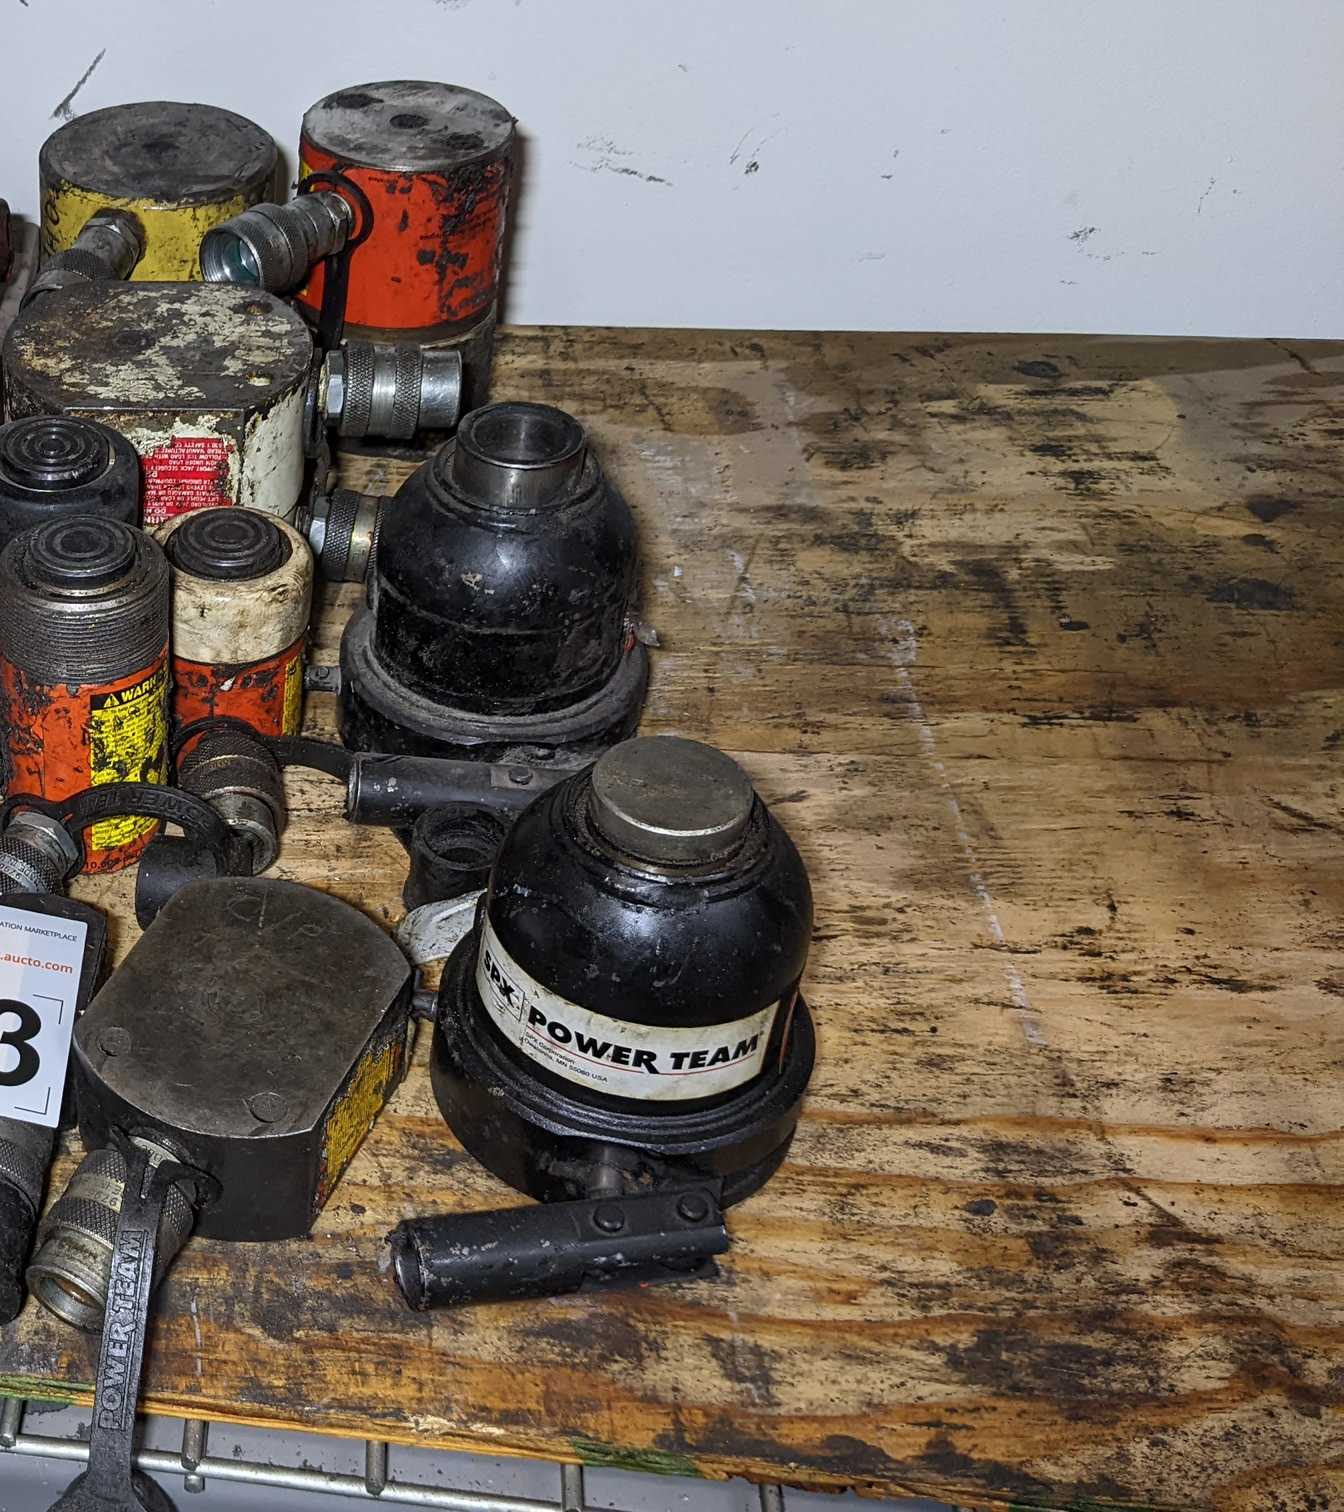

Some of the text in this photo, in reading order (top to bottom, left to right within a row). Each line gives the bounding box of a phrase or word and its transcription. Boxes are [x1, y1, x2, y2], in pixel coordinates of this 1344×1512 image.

[24, 926, 77, 942] MARKETPLACE
[484, 950, 759, 1075] SPX POWER TEAM
[591, 1073, 608, 1083] USA
[98, 1229, 144, 1430] POWER TEAM
